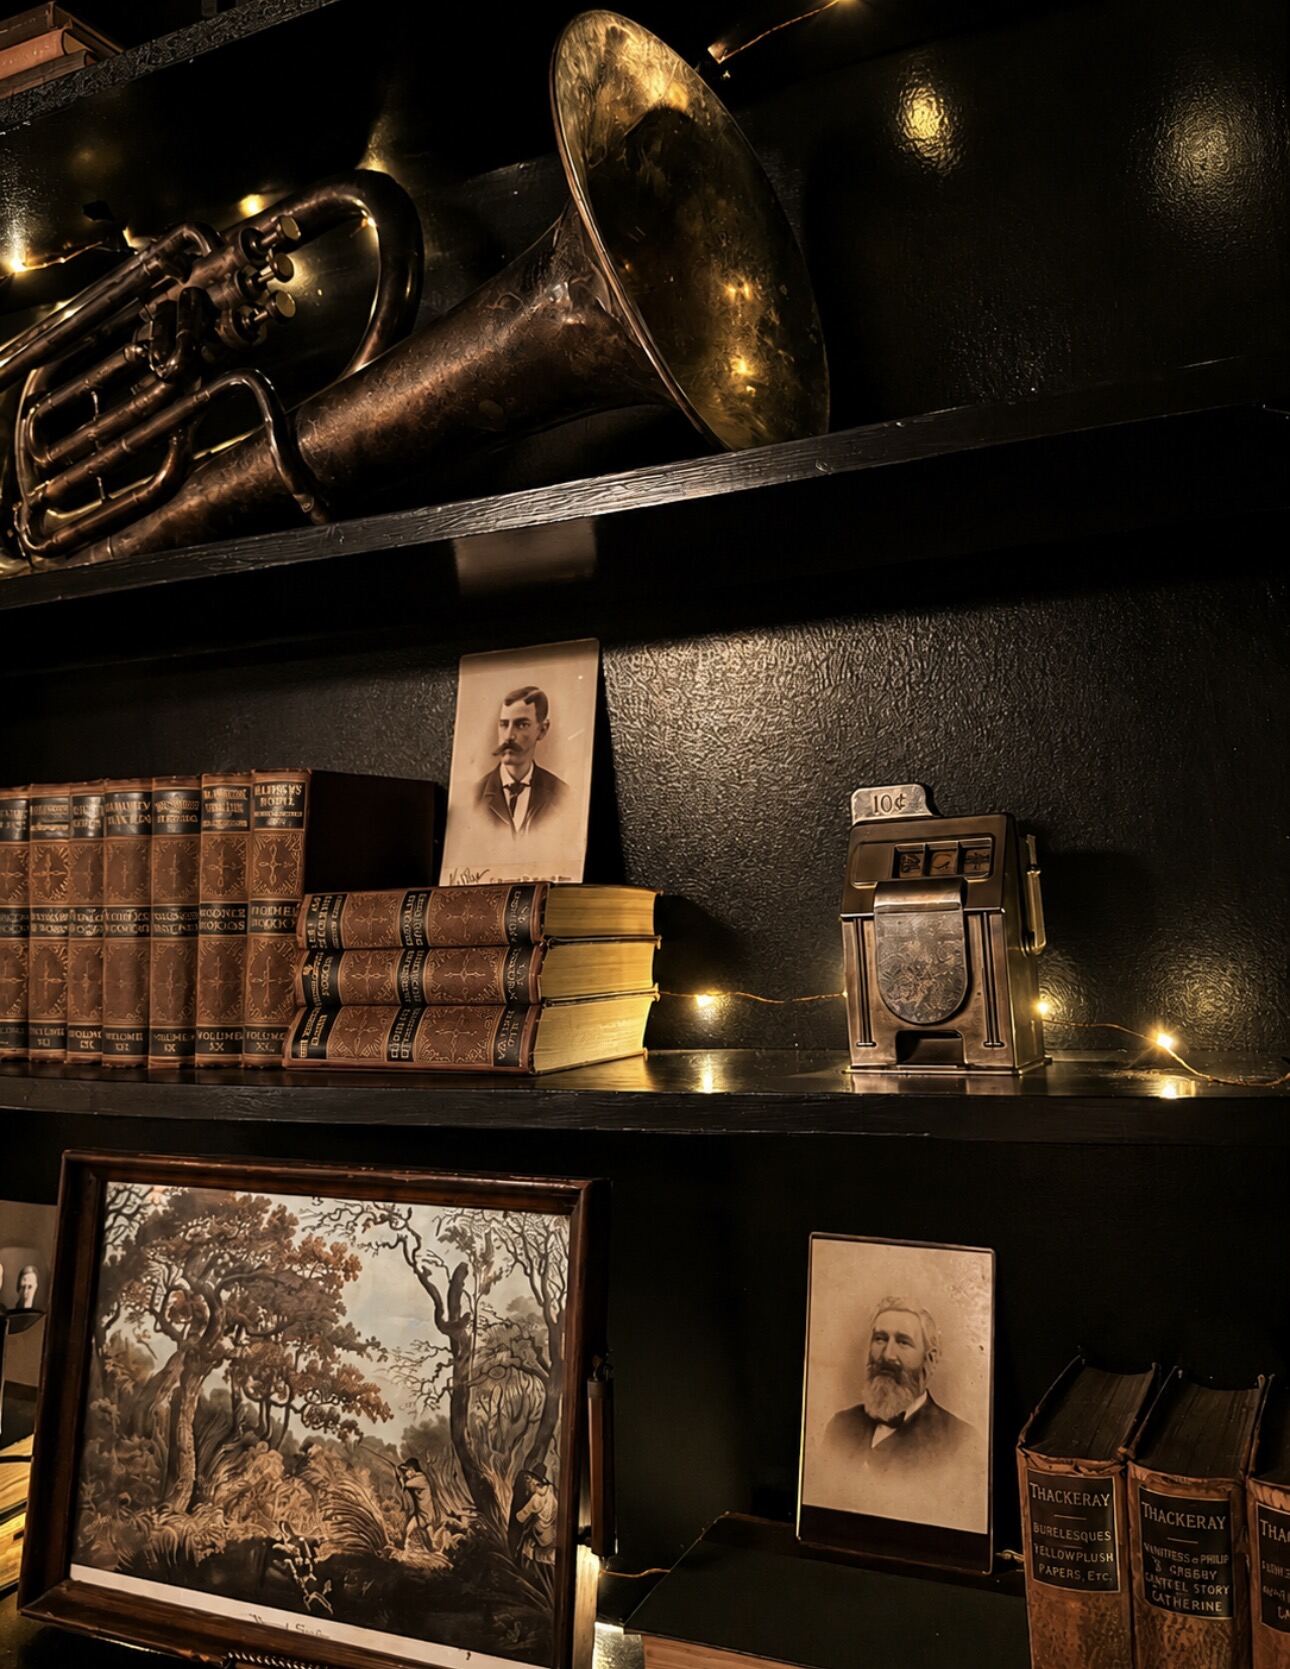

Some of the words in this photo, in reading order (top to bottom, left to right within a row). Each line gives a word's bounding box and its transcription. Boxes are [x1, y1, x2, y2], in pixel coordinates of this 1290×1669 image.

[874, 793, 906, 813] 10¢
[1029, 1482, 1110, 1507] THACKERAY
[1141, 1501, 1227, 1530] THACKERAY
[1033, 1543, 1114, 1563] YELLOWPLUSH
[1193, 1584, 1230, 1596] STORY
[1151, 1590, 1223, 1612] CATHERINE
